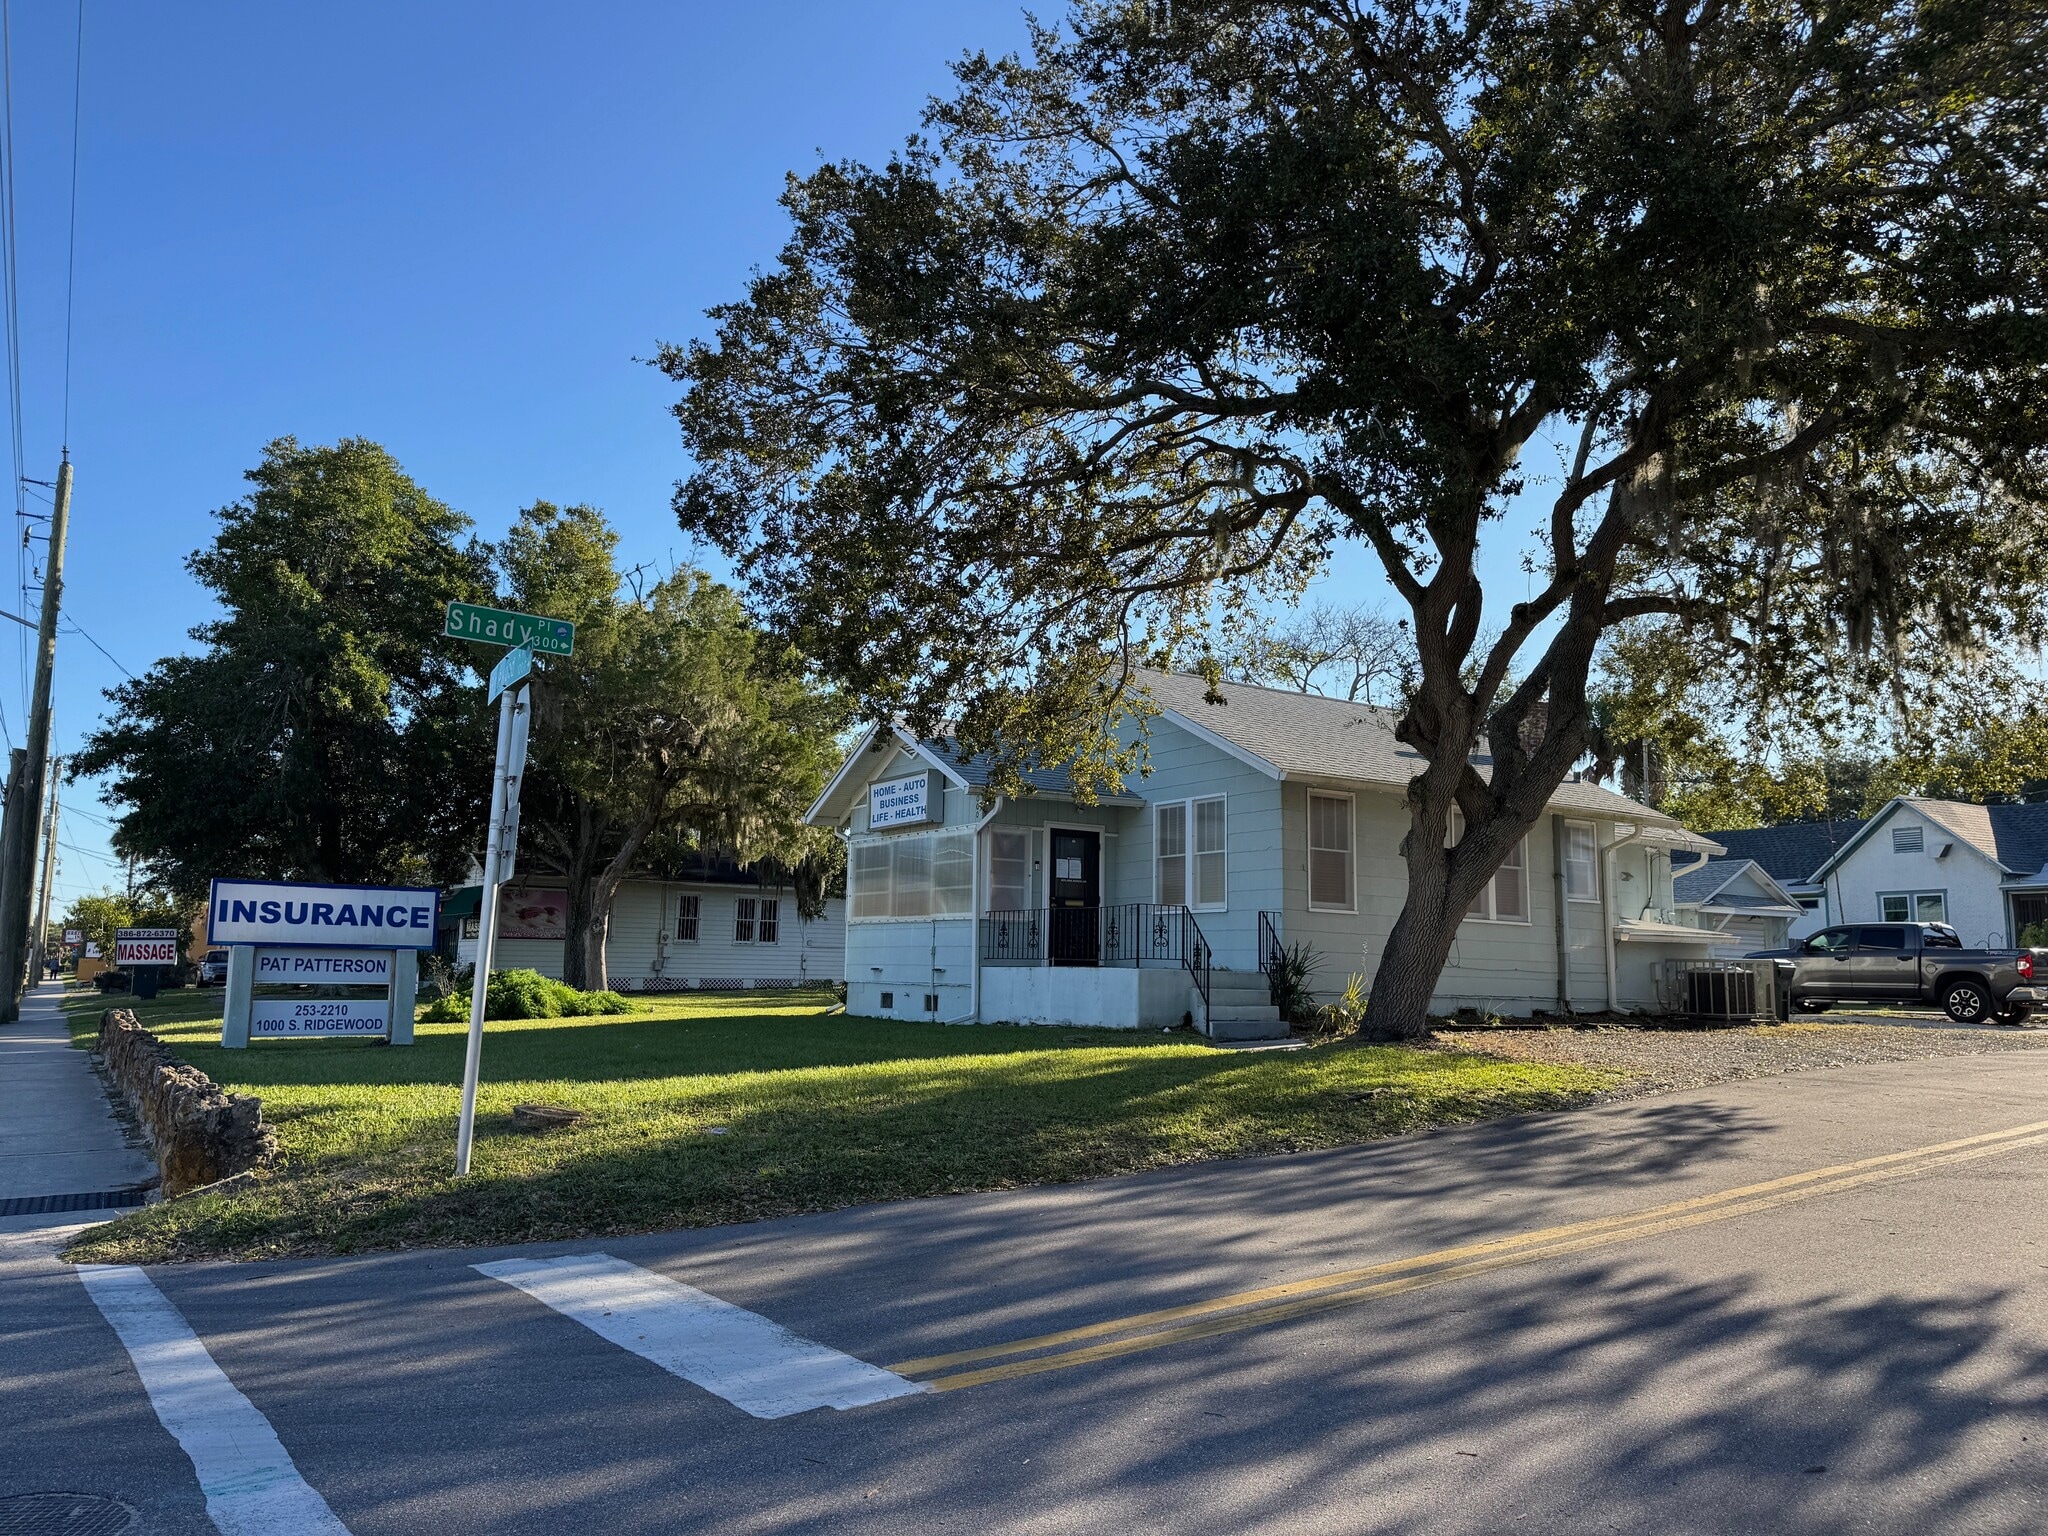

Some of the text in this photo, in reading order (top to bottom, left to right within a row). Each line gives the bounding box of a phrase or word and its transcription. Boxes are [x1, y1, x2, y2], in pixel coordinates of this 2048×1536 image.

[450, 609, 532, 643] Shady
[533, 635, 559, 650] 300
[873, 785, 896, 798] HOME
[903, 779, 926, 792] AUTO
[879, 793, 920, 809] BUSINESS
[872, 812, 889, 823] LIFE
[895, 804, 927, 819] HEALTH
[218, 899, 430, 929] INSURANCE
[117, 943, 175, 961] MASSAGE
[260, 957, 387, 974] PAT PATTERSON
[295, 1004, 349, 1017] 253-2210
[256, 1018, 383, 1032] 1000 S. RIDGEWOOD
